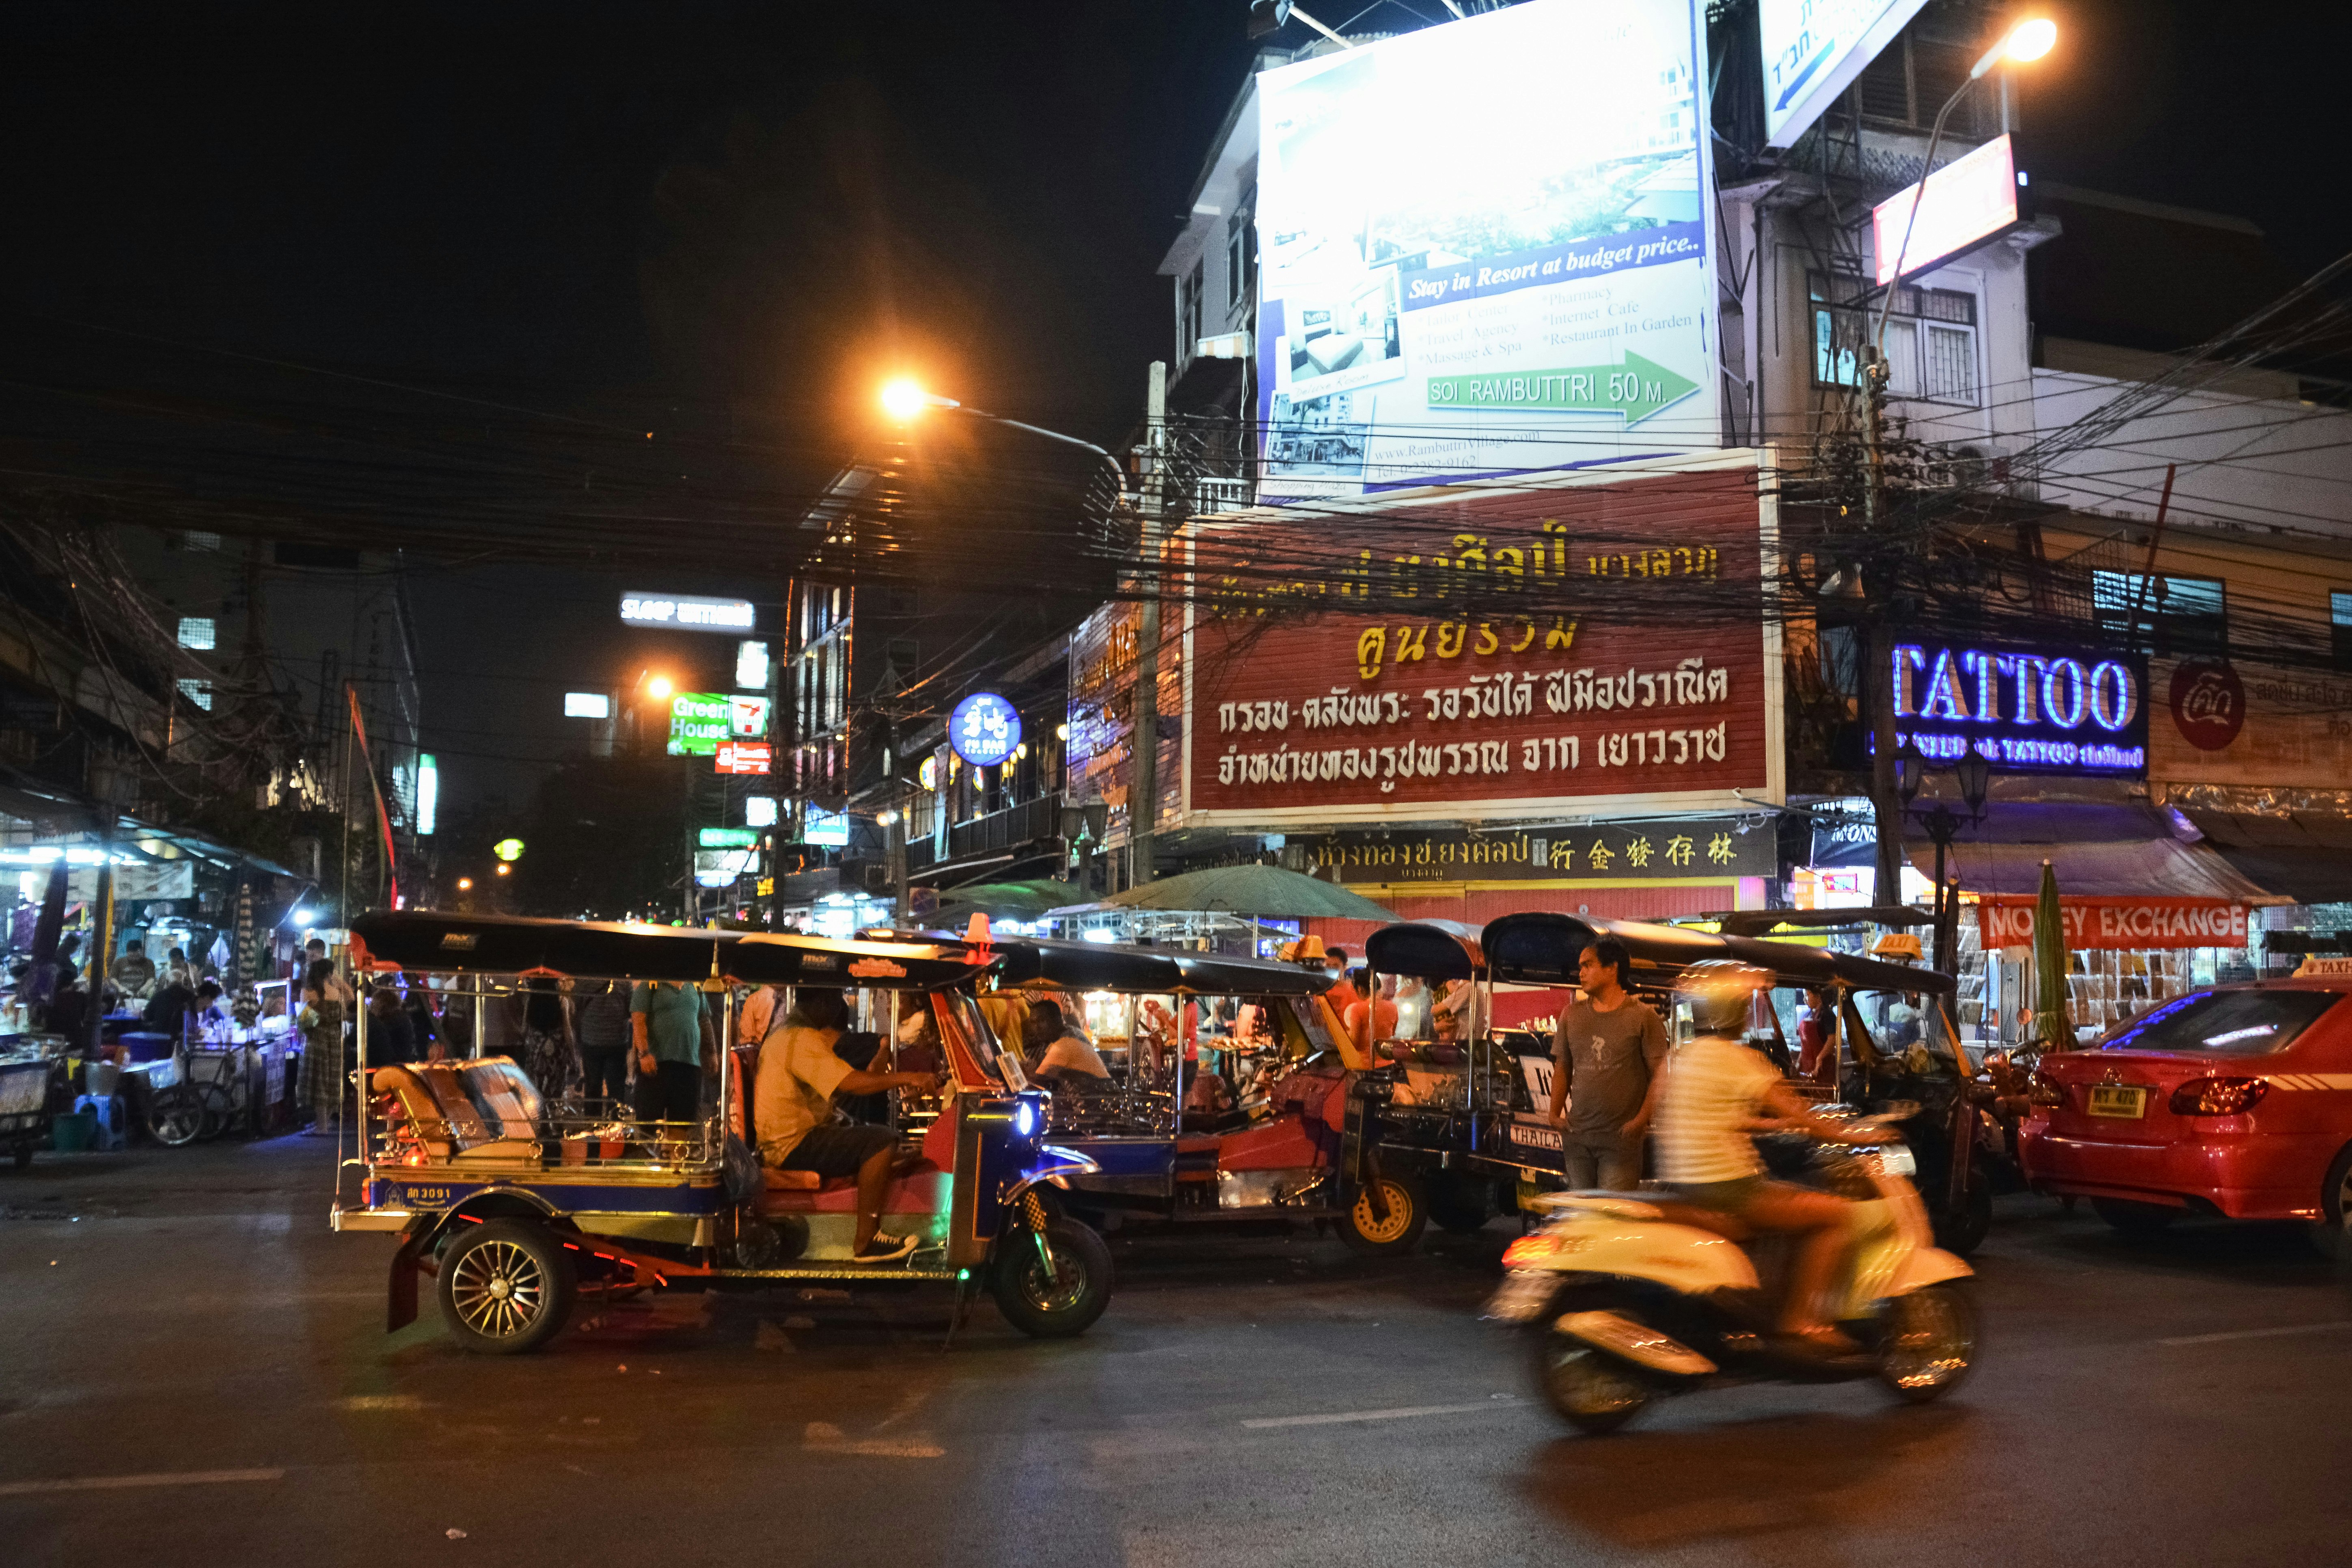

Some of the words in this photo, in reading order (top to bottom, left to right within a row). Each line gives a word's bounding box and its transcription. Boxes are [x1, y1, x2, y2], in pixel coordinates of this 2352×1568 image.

[1408, 276, 1449, 300] Stay
[1452, 272, 1470, 289] in
[1476, 261, 1538, 287] Resort
[1542, 258, 1562, 276] at
[1566, 243, 1633, 270] budget
[1550, 286, 1613, 306] Pharmacy
[1425, 313, 1460, 328] Tailor
[1467, 304, 1510, 320] Center
[1550, 308, 1599, 325] Internet
[1608, 300, 1639, 317] Cafe
[1424, 329, 1463, 346] Travel
[1471, 322, 1519, 341] Agency
[1550, 324, 1619, 345] Restaurant
[1624, 322, 1638, 335] In
[1642, 315, 1692, 332] Garden
[1425, 348, 1478, 366] Massage
[1482, 343, 1493, 356] &
[1498, 342, 1522, 357] Spa
[1431, 382, 1459, 401] SOI
[1469, 373, 1595, 402] RAMBUTTRI
[1608, 371, 1640, 402] 50
[1646, 381, 1668, 402] M.
[1892, 644, 2138, 730] TATTOO
[673, 697, 729, 719] Green
[671, 717, 729, 739] House
[1522, 735, 1580, 771] จาก
[1598, 720, 1726, 767] เยาวราช
[1988, 906, 2087, 937] MOEY
[2100, 906, 2245, 938] EXCHANGE
[421, 1187, 450, 1199] 3091
